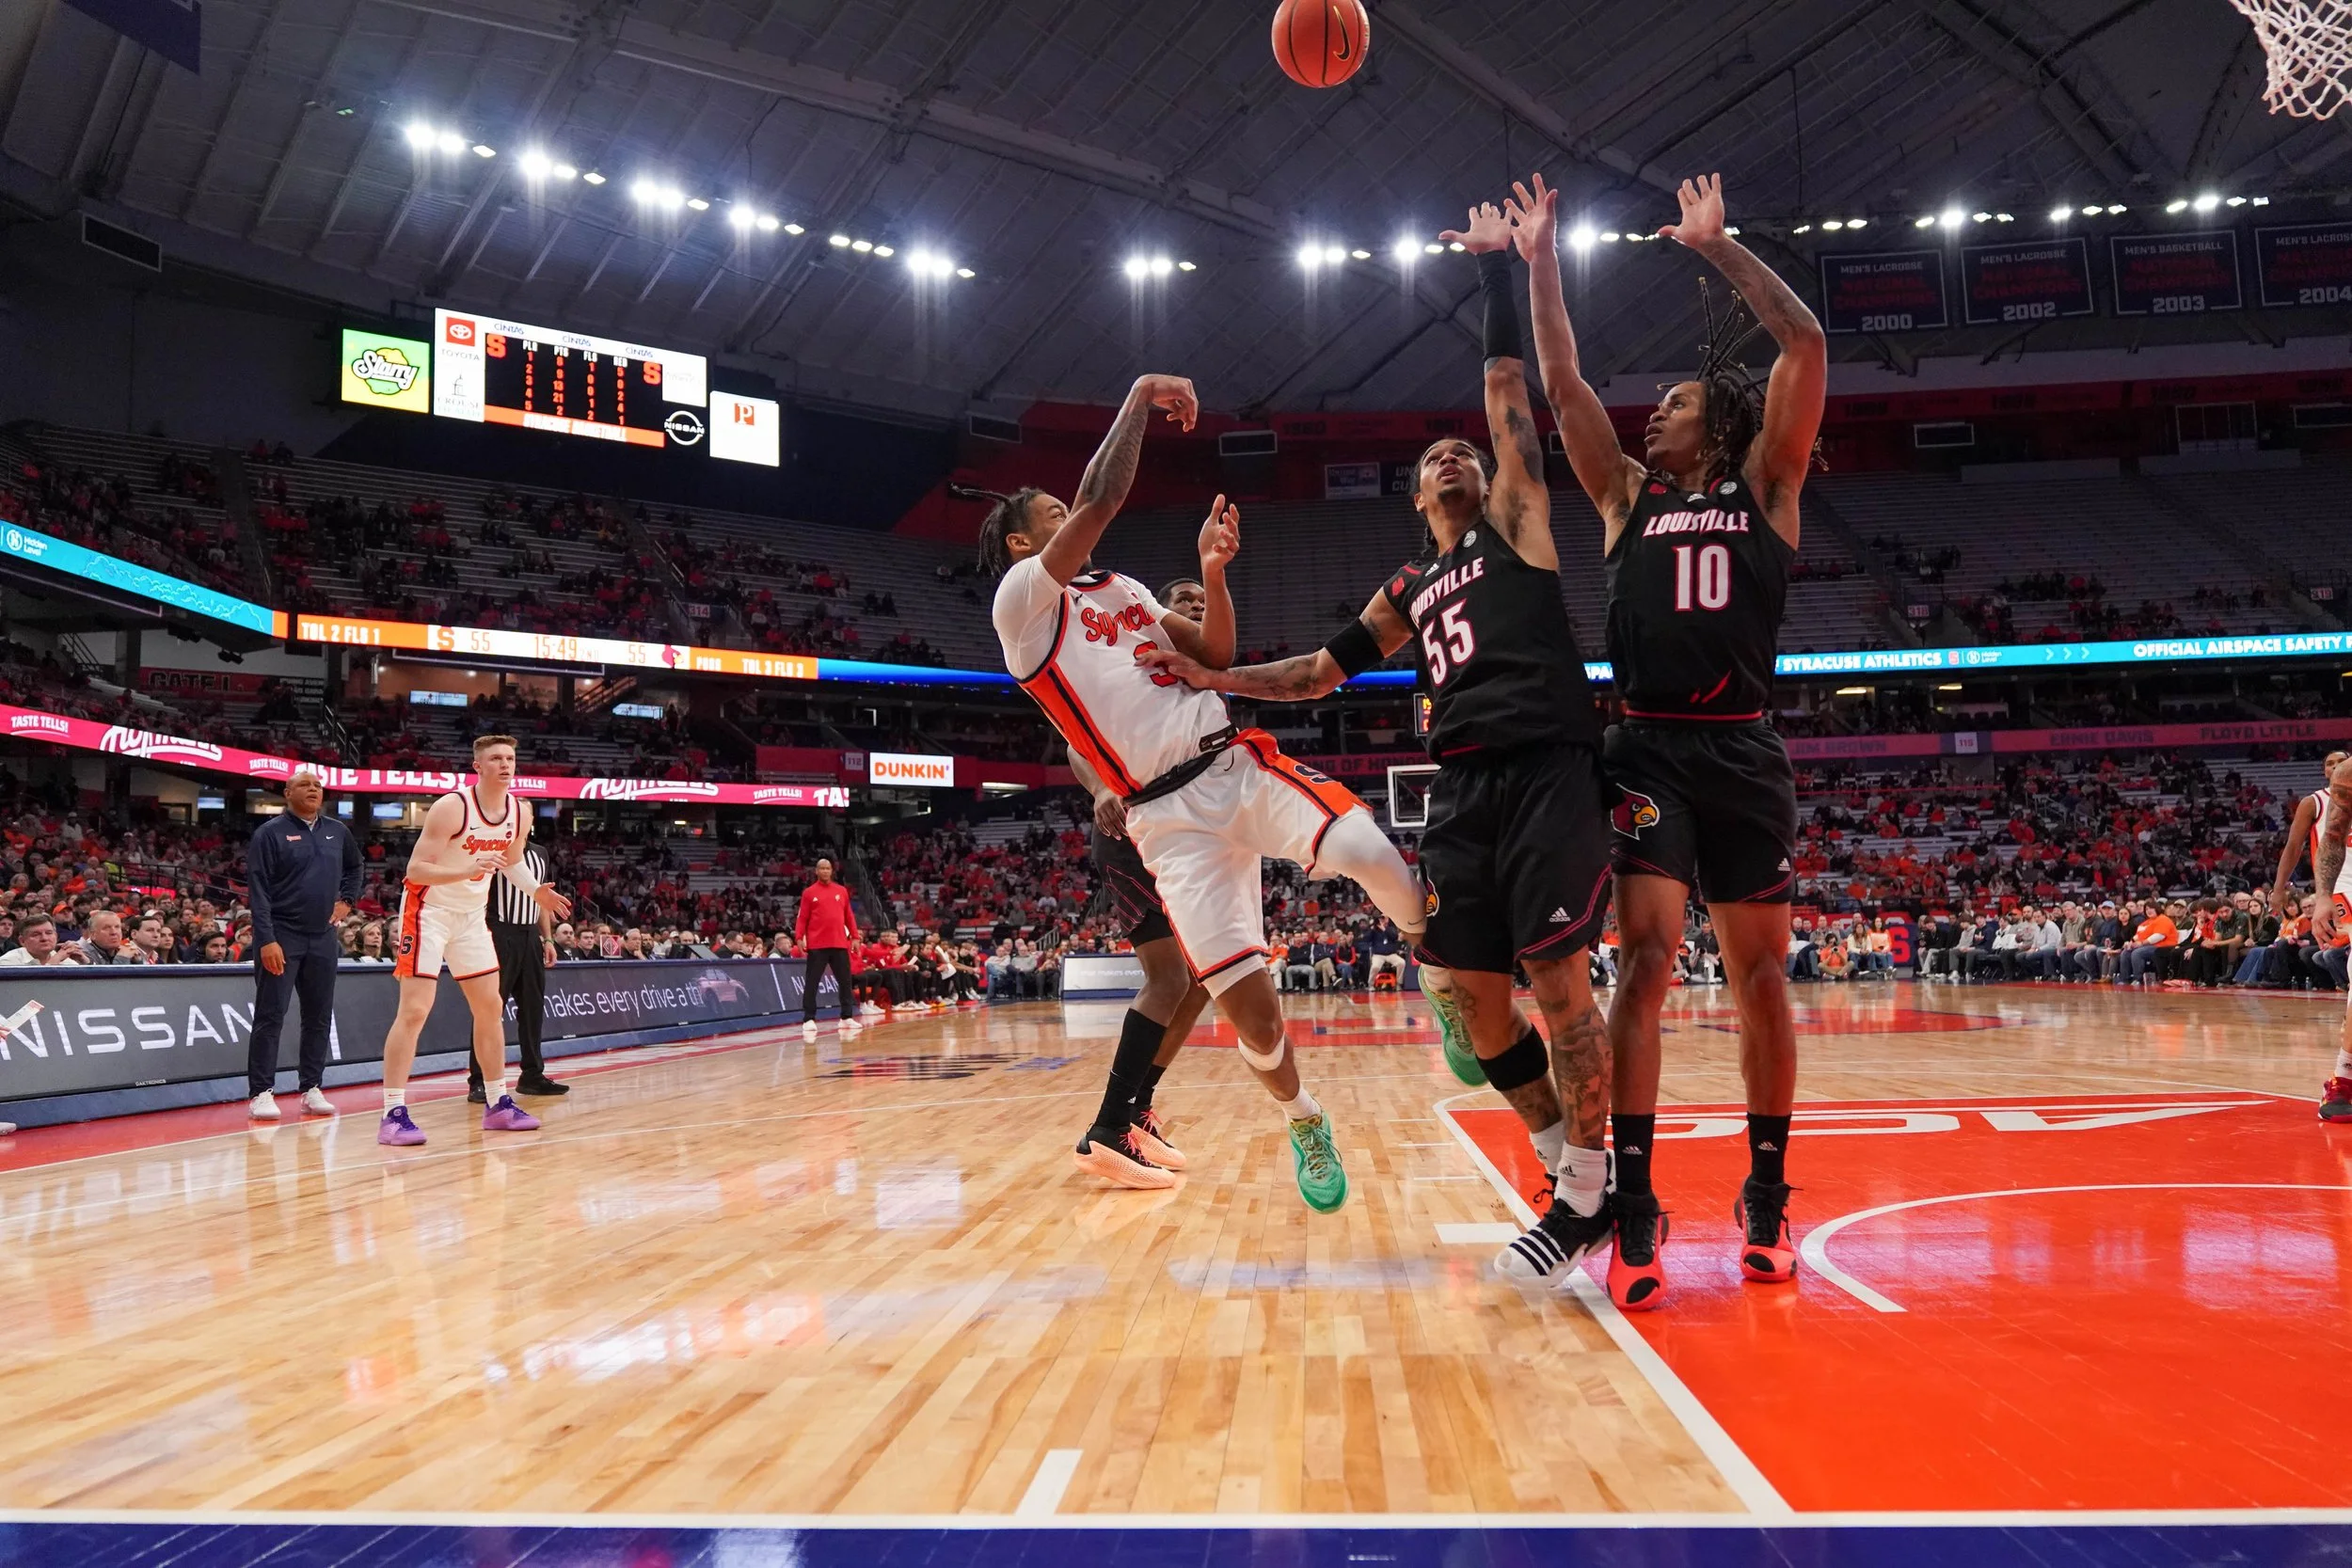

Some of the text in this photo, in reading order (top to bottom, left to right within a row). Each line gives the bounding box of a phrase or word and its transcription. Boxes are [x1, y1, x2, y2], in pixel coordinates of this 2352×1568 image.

[2310, 233, 2352, 245] LACROS
[1980, 249, 2067, 264] MEN'S LACROSSE
[2124, 242, 2224, 256] MEN'S BASKETBALL
[1840, 261, 1924, 274] MEN'S LACROSSE
[2003, 301, 2057, 322] 2002
[2153, 294, 2205, 313] 2003
[1861, 313, 1914, 330] 2000
[441, 348, 481, 361] TOYOTA
[351, 348, 421, 391] Starry
[525, 363, 533, 374] 2
[525, 374, 533, 386] 3
[617, 390, 625, 402] 2
[525, 388, 533, 399] 4
[552, 391, 564, 404] 21
[616, 403, 625, 414] 4
[524, 400, 533, 411] 5
[556, 404, 564, 416] 2
[587, 409, 595, 420] 2
[664, 420, 706, 436] NISSAN
[1643, 508, 1751, 537] LOUISVILLE
[24, 535, 47, 549] Hidden
[24, 545, 41, 557] Level
[1671, 543, 1732, 611] 10
[331, 625, 341, 641] 2
[373, 628, 380, 644] 1
[470, 631, 490, 651] 55
[534, 636, 578, 660] 15:49
[628, 643, 645, 664] 55
[1421, 597, 1476, 688] 55
[2133, 641, 2204, 657] OFFICIAL
[2206, 638, 2281, 656] AIRSPACE
[2285, 636, 2343, 653] SAFETY
[1783, 655, 1861, 672] SYRACUSE
[1864, 652, 1943, 669] ATHLETICS
[148, 671, 216, 691] GATE
[11, 715, 69, 734] TASTE TELLS!
[2201, 722, 2316, 739] FLOYD LITTLE
[1826, 739, 1886, 752] BROWN
[2049, 730, 2153, 747] ERNIE DAVIS
[248, 758, 288, 772] TASTE TELLS!
[847, 756, 863, 767] 112
[1342, 757, 1362, 771] OF
[874, 762, 950, 780] DUNKIN'
[518, 779, 547, 790] TELLS!
[754, 787, 803, 800] TASTE TELLS!
[596, 990, 642, 1018] every
[641, 983, 675, 1010] drive
[676, 988, 688, 1007] a
